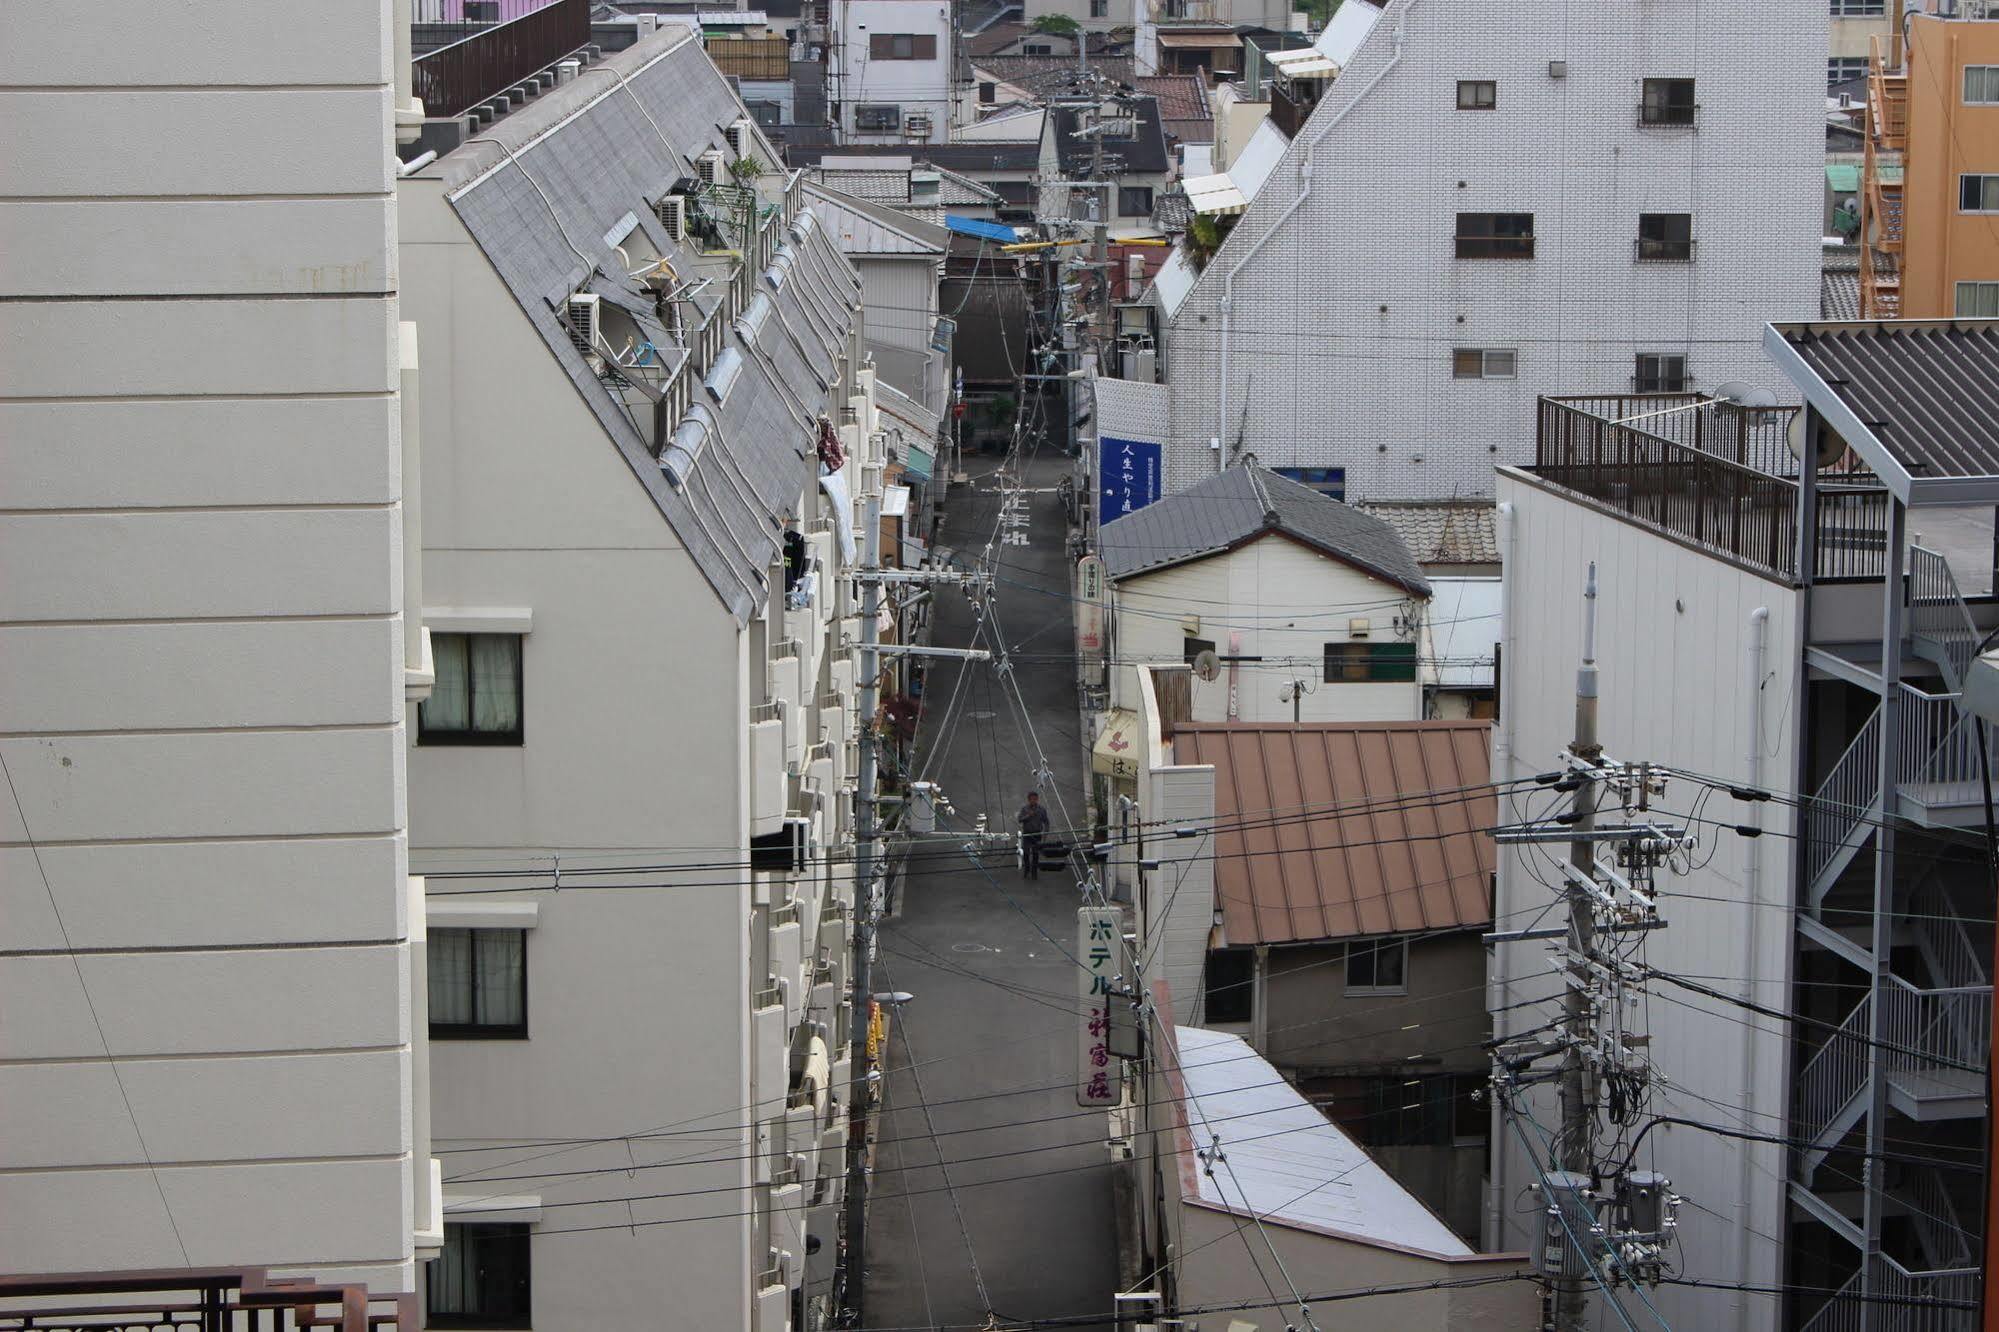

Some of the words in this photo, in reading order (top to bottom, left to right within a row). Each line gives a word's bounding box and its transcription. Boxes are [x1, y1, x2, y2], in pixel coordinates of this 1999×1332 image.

[1121, 445, 1135, 512] 人生やり直
[1089, 920, 1112, 995] ホテル
